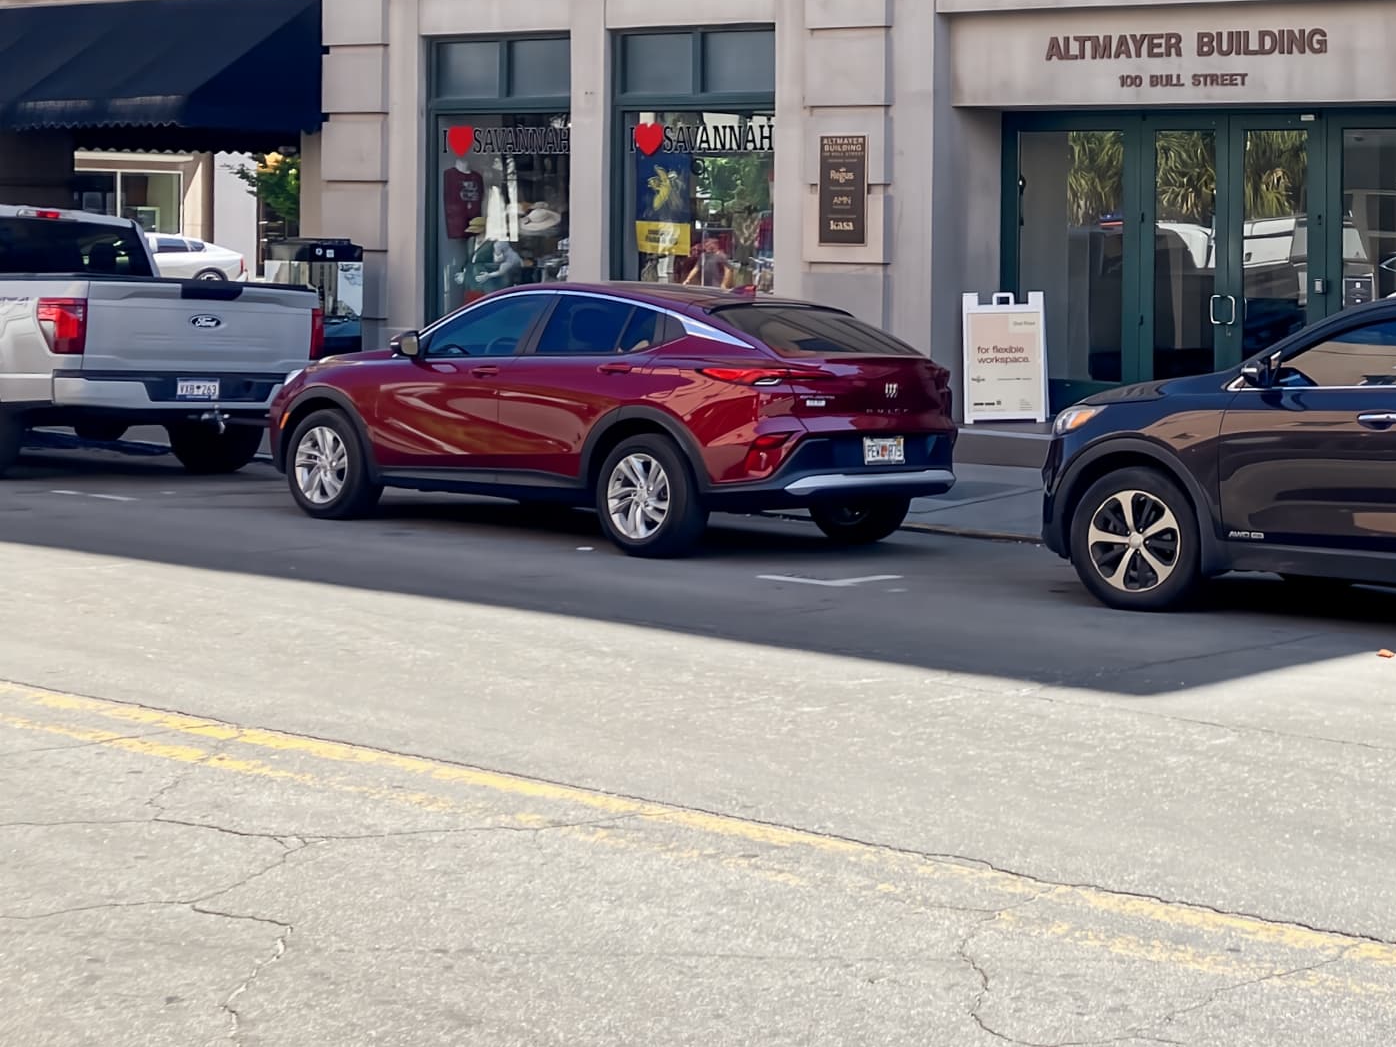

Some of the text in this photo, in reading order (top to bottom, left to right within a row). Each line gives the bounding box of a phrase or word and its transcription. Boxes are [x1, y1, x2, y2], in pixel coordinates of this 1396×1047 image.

[1046, 28, 1328, 61] ALTMAYER BUILDING
[1119, 73, 1248, 88] 100 BULL STREET
[472, 124, 571, 154] SAVANNAH
[663, 123, 774, 153] SAVANNAH
[824, 144, 862, 152] BUILDING
[829, 219, 853, 231] kasa
[977, 345, 1025, 354] for flexible
